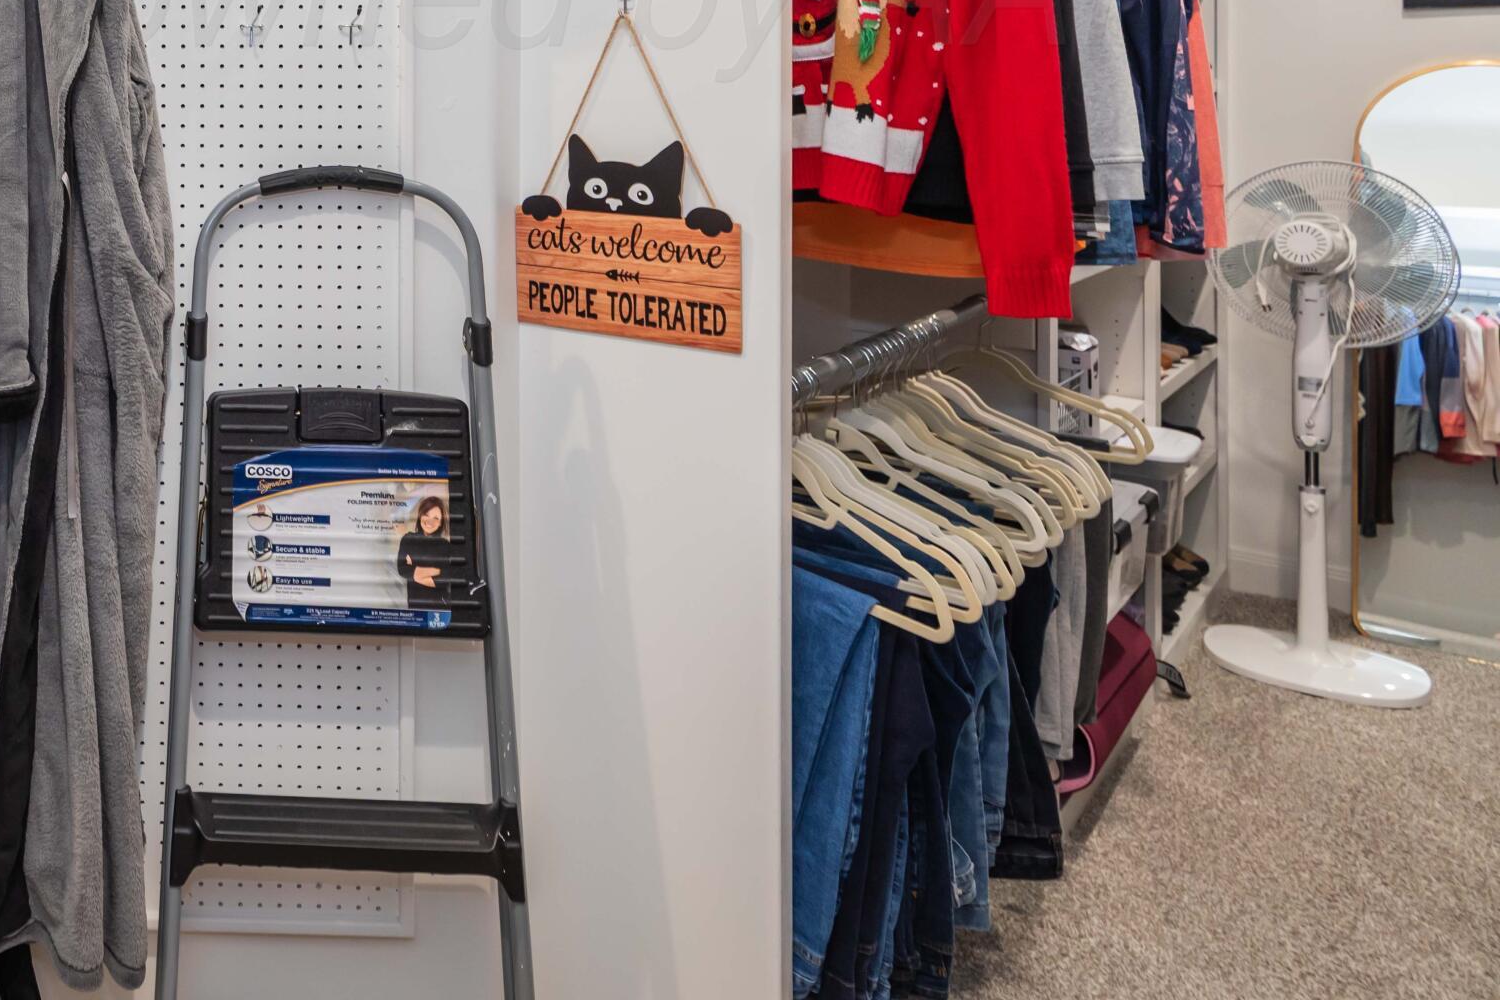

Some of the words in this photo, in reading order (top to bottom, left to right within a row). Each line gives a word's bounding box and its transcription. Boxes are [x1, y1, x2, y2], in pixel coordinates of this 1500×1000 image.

[527, 217, 587, 254] cats
[591, 223, 726, 269] welcome
[528, 280, 598, 320] PEOPLE
[607, 291, 727, 337] TOLERATED
[247, 466, 290, 477] COSCO
[257, 479, 292, 495] Signature
[361, 491, 394, 499] Premium
[275, 515, 314, 523] Lightweight
[434, 613, 440, 621] 3
